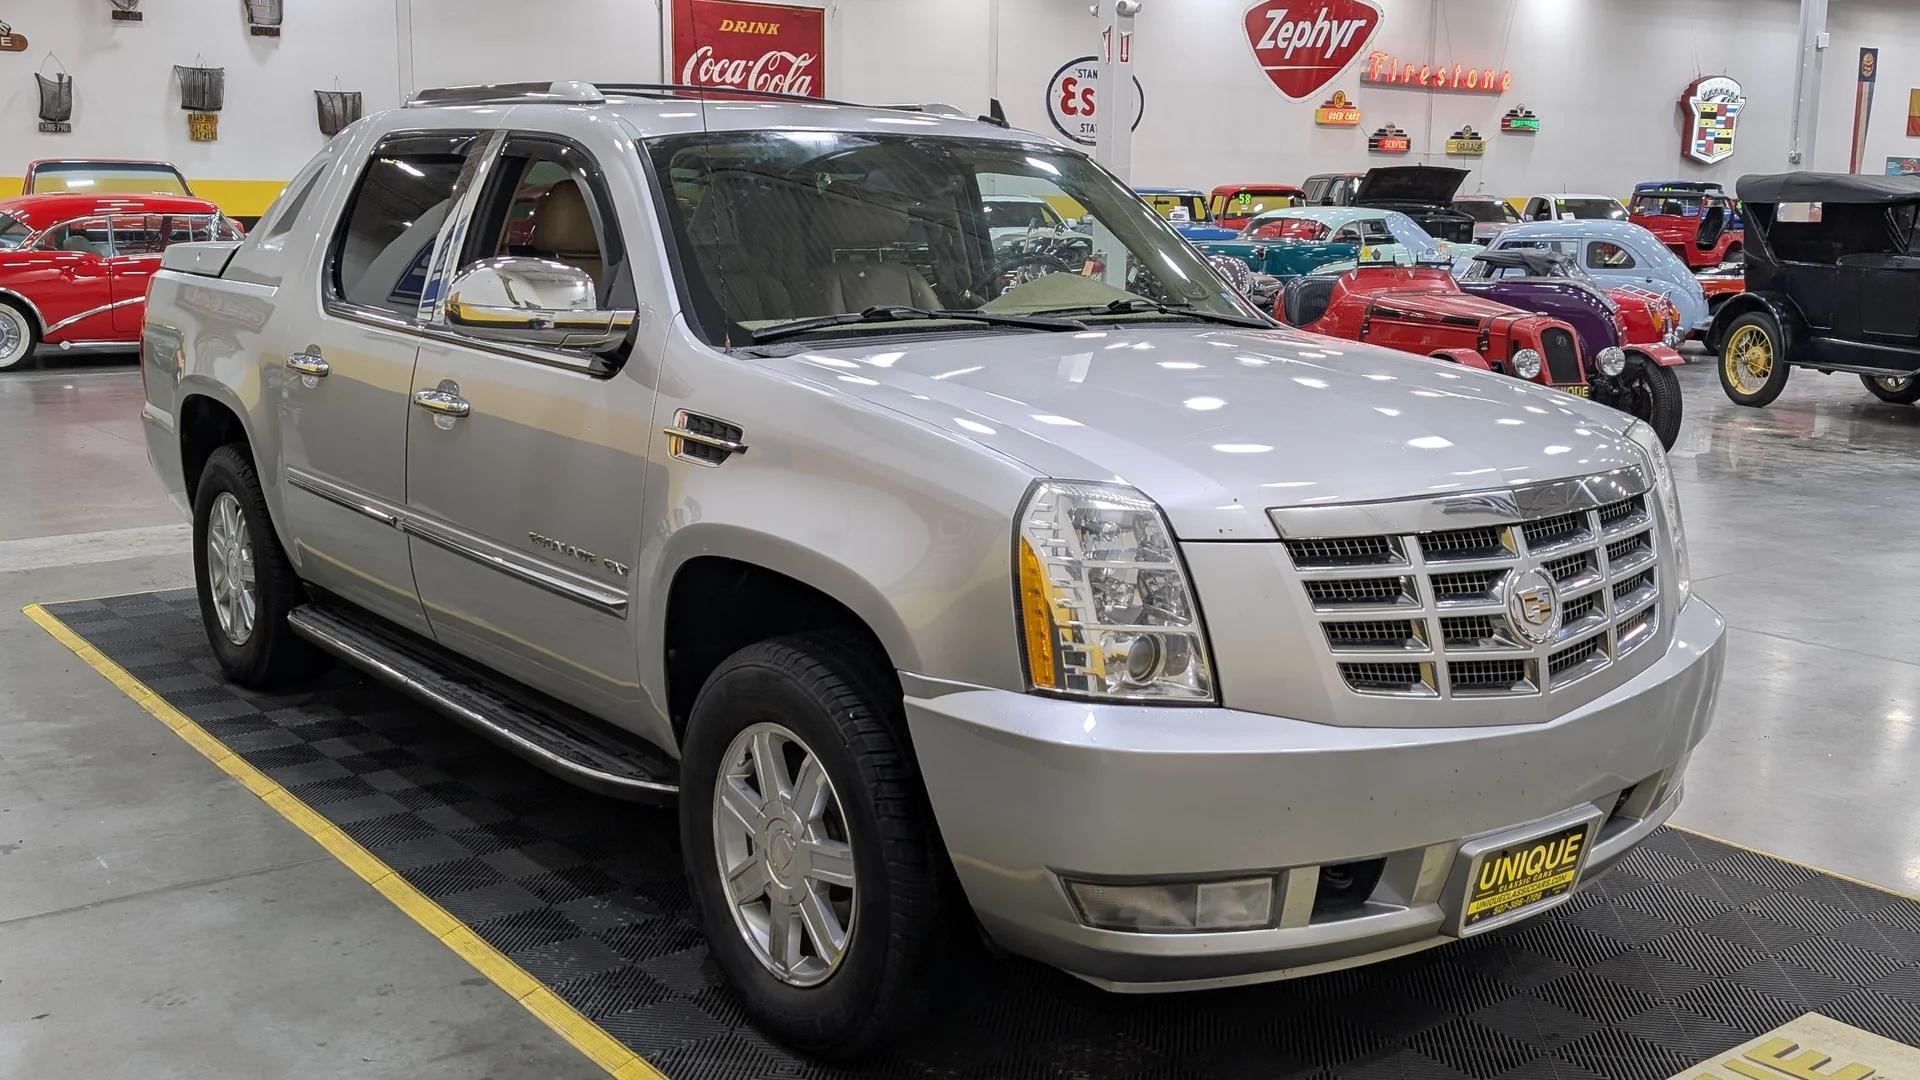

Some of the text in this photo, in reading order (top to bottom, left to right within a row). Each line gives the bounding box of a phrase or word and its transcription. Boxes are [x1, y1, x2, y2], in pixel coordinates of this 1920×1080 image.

[719, 19, 780, 35] DRINK
[1255, 7, 1367, 59] Zephyr
[682, 45, 817, 97] Coca-Cola
[1369, 51, 1513, 92] Firestone
[1060, 76, 1096, 116] Es
[1080, 123, 1097, 133] STA
[1238, 193, 1251, 205] 58
[1480, 833, 1582, 890] UNIQUE
[1499, 869, 1553, 892] CLASSIC CARS
